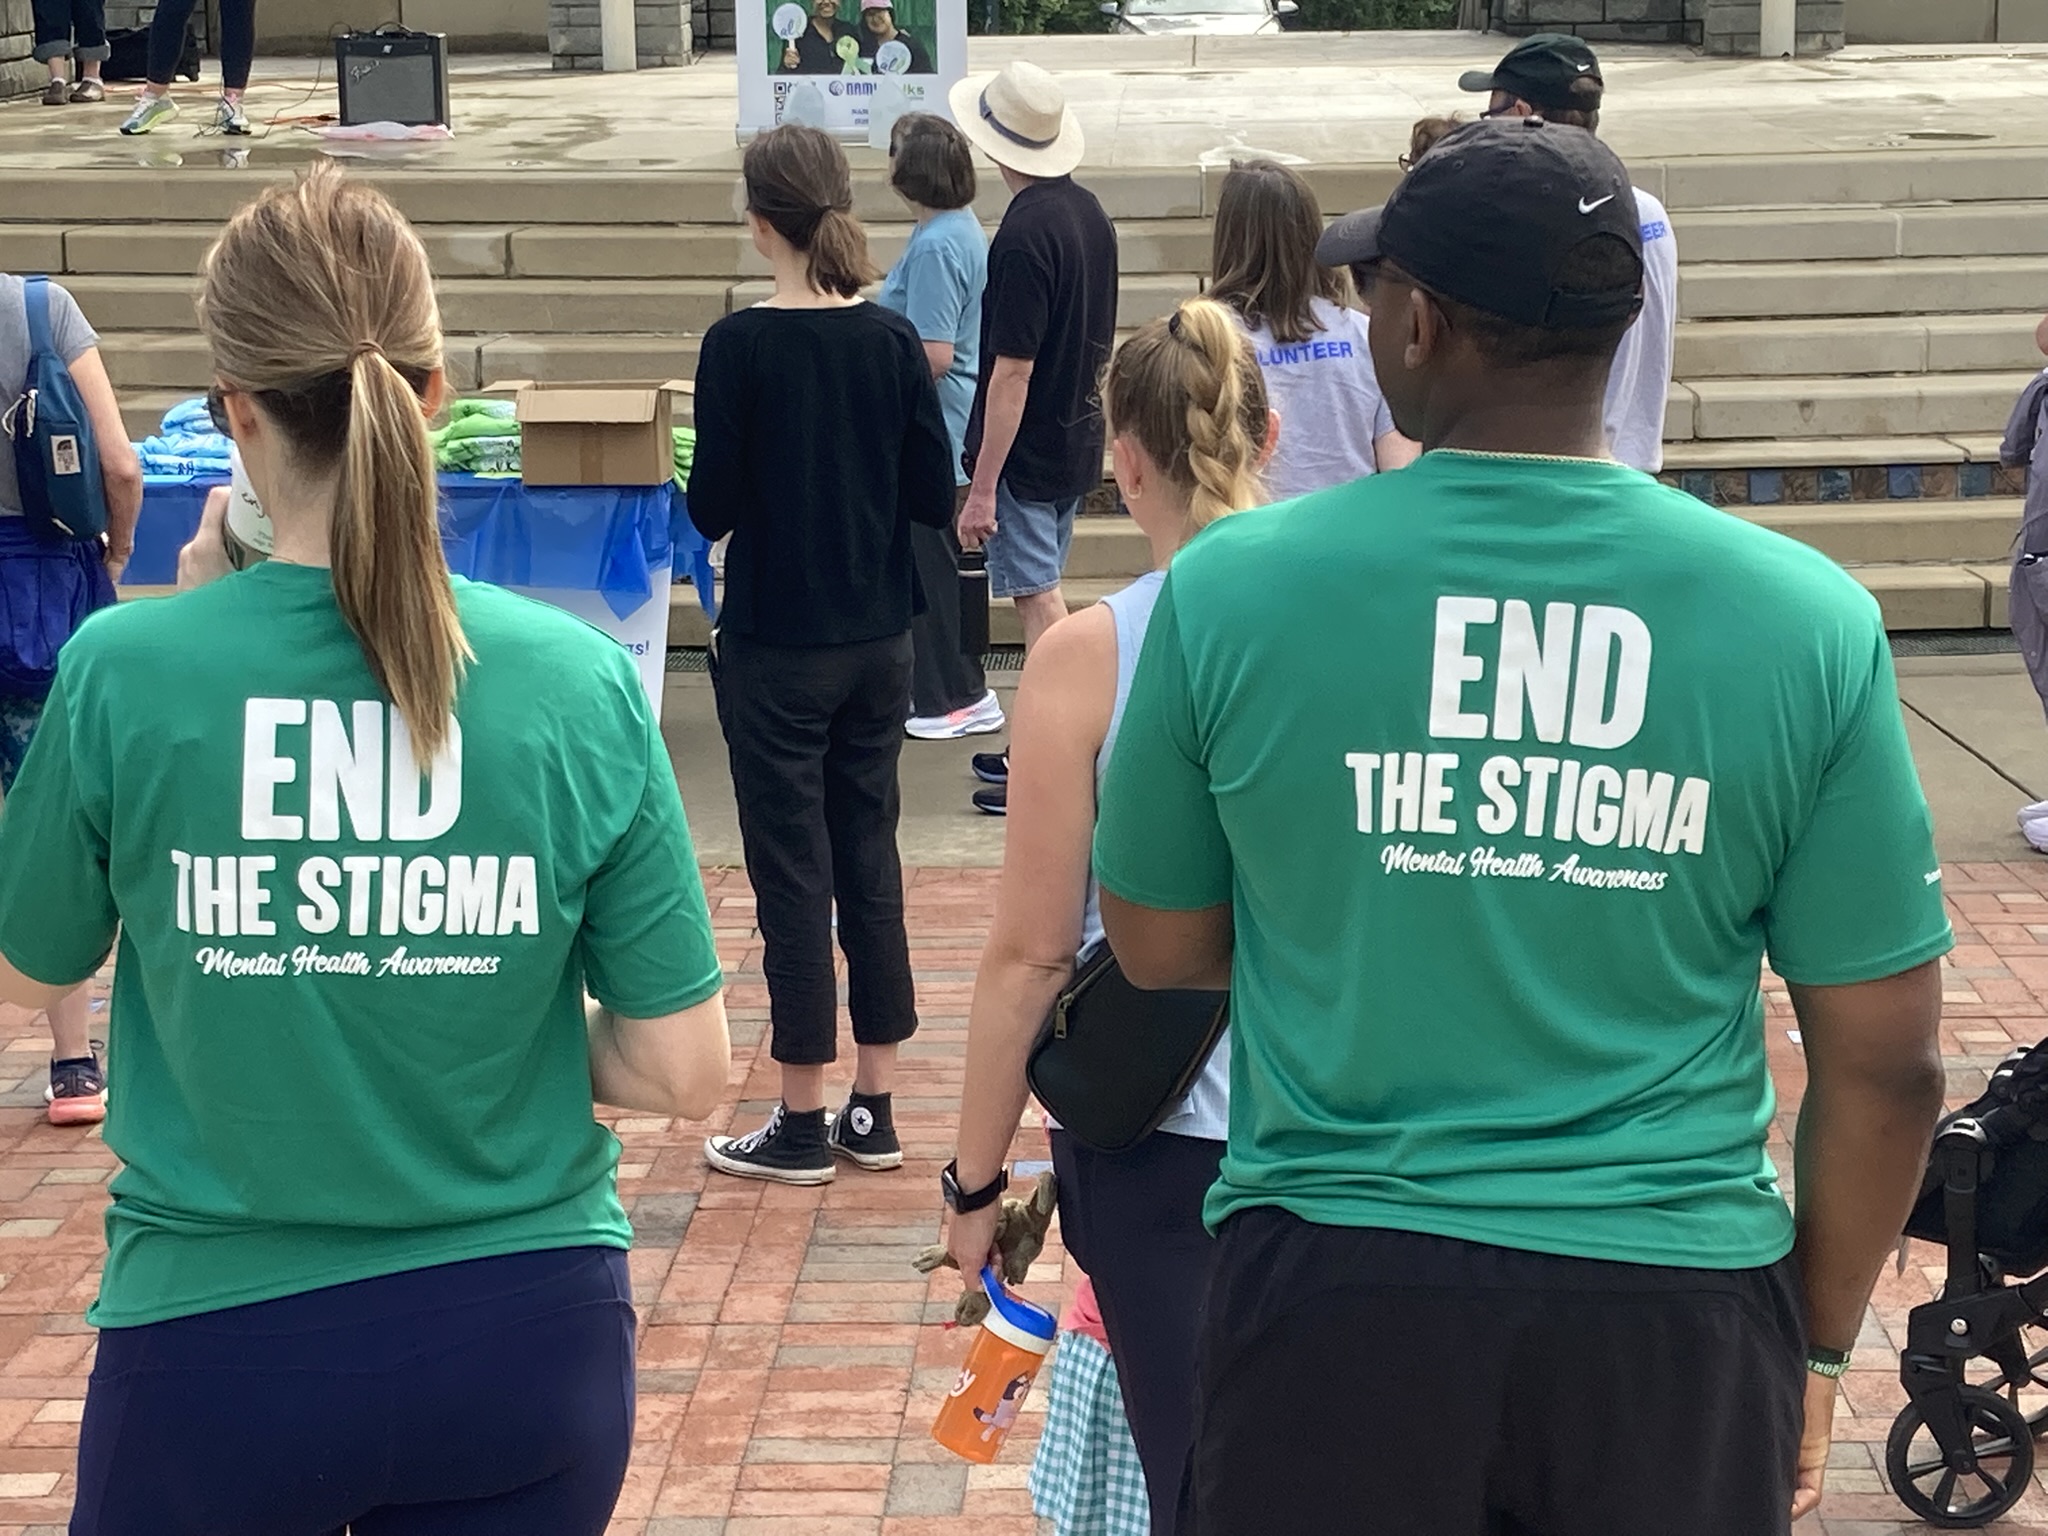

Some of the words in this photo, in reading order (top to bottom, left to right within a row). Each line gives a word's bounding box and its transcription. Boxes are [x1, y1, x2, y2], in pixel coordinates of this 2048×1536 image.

[1256, 341, 1353, 366] LUNTEER
[1427, 595, 1654, 750] END
[240, 696, 463, 843] END
[1345, 752, 1460, 835] THE
[1476, 755, 1711, 856] STIGMA
[171, 849, 277, 937] THE
[296, 855, 541, 937] STIGMA
[1380, 841, 1466, 876] Mental
[1470, 845, 1546, 878] Health
[1548, 853, 1669, 892] Awareness
[195, 946, 288, 978] Mental
[291, 944, 373, 977] Health
[374, 946, 501, 979] Awareness
